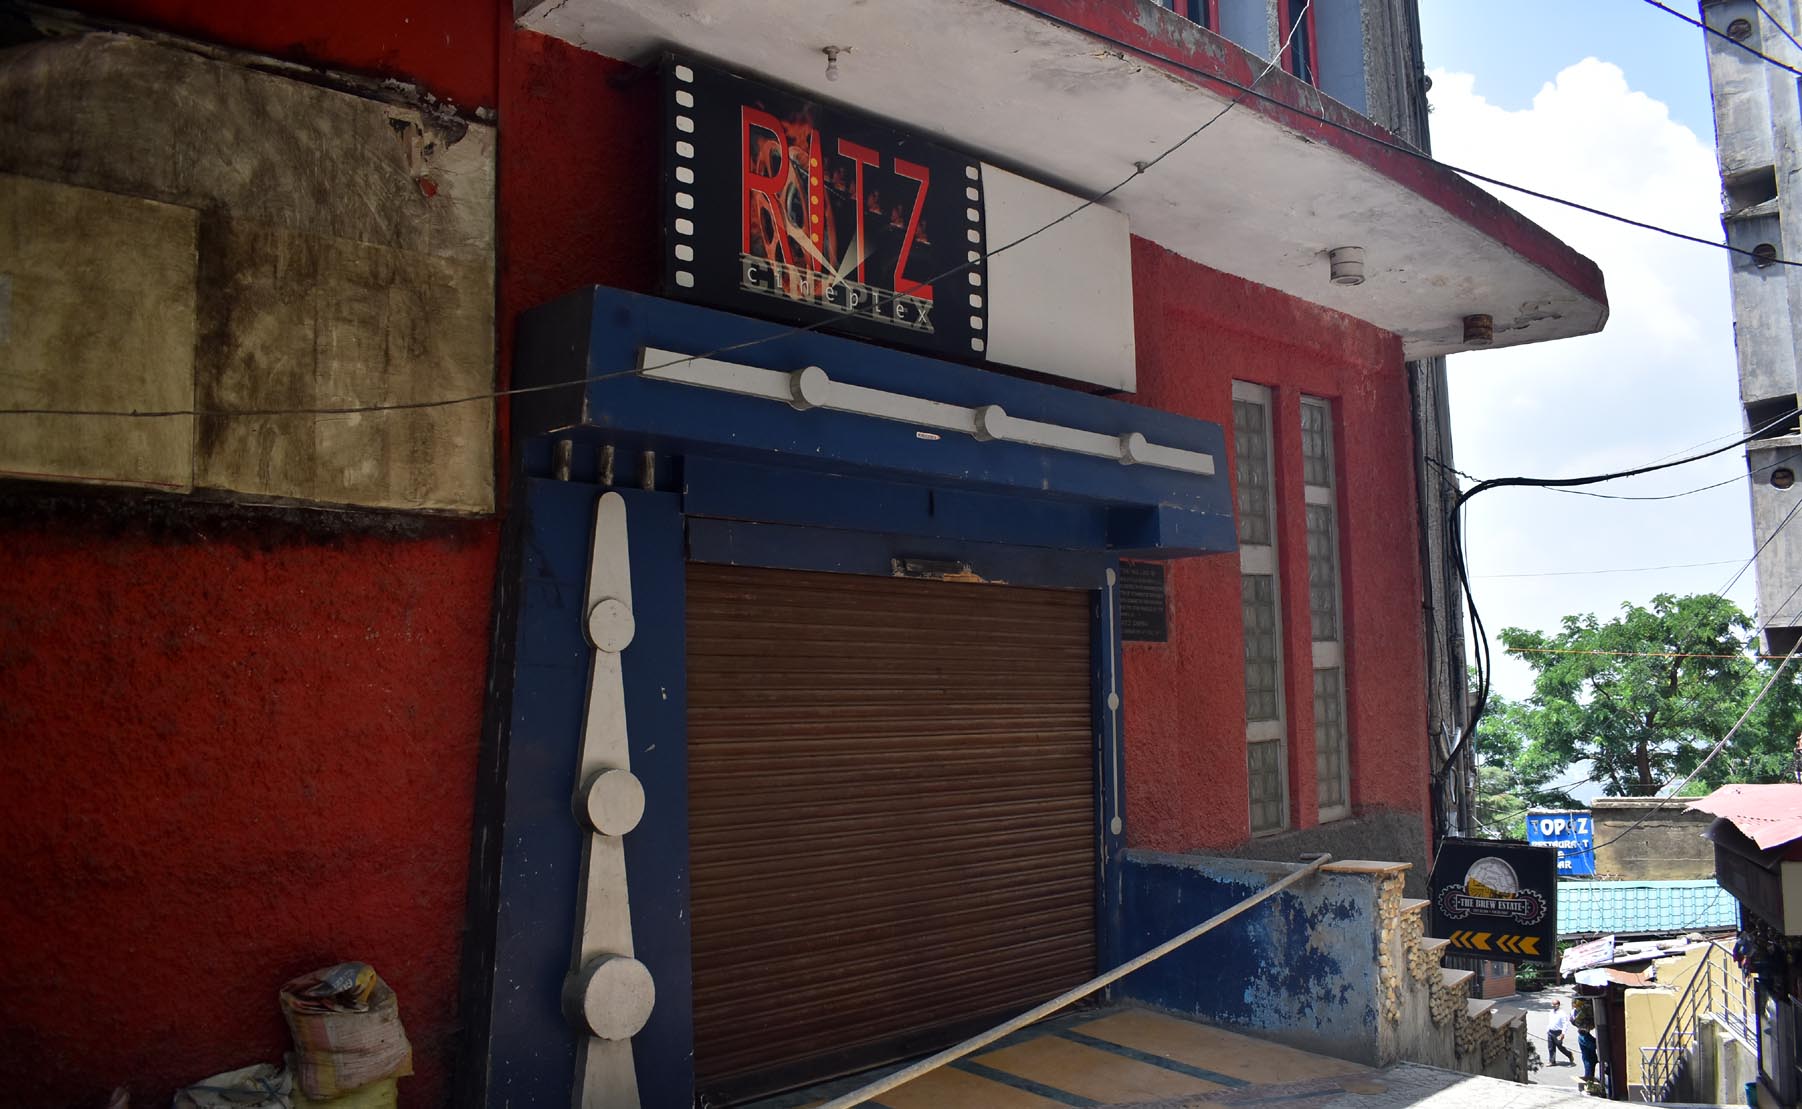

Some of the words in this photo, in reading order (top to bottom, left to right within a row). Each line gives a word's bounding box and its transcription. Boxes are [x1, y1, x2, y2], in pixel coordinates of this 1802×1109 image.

[740, 104, 934, 302] RITZ
[747, 267, 928, 324] cineplex
[1557, 860, 1572, 869] AR
[1460, 898, 1474, 908] THE
[1475, 899, 1496, 910] BREW
[1498, 901, 1522, 911] ESTATE
